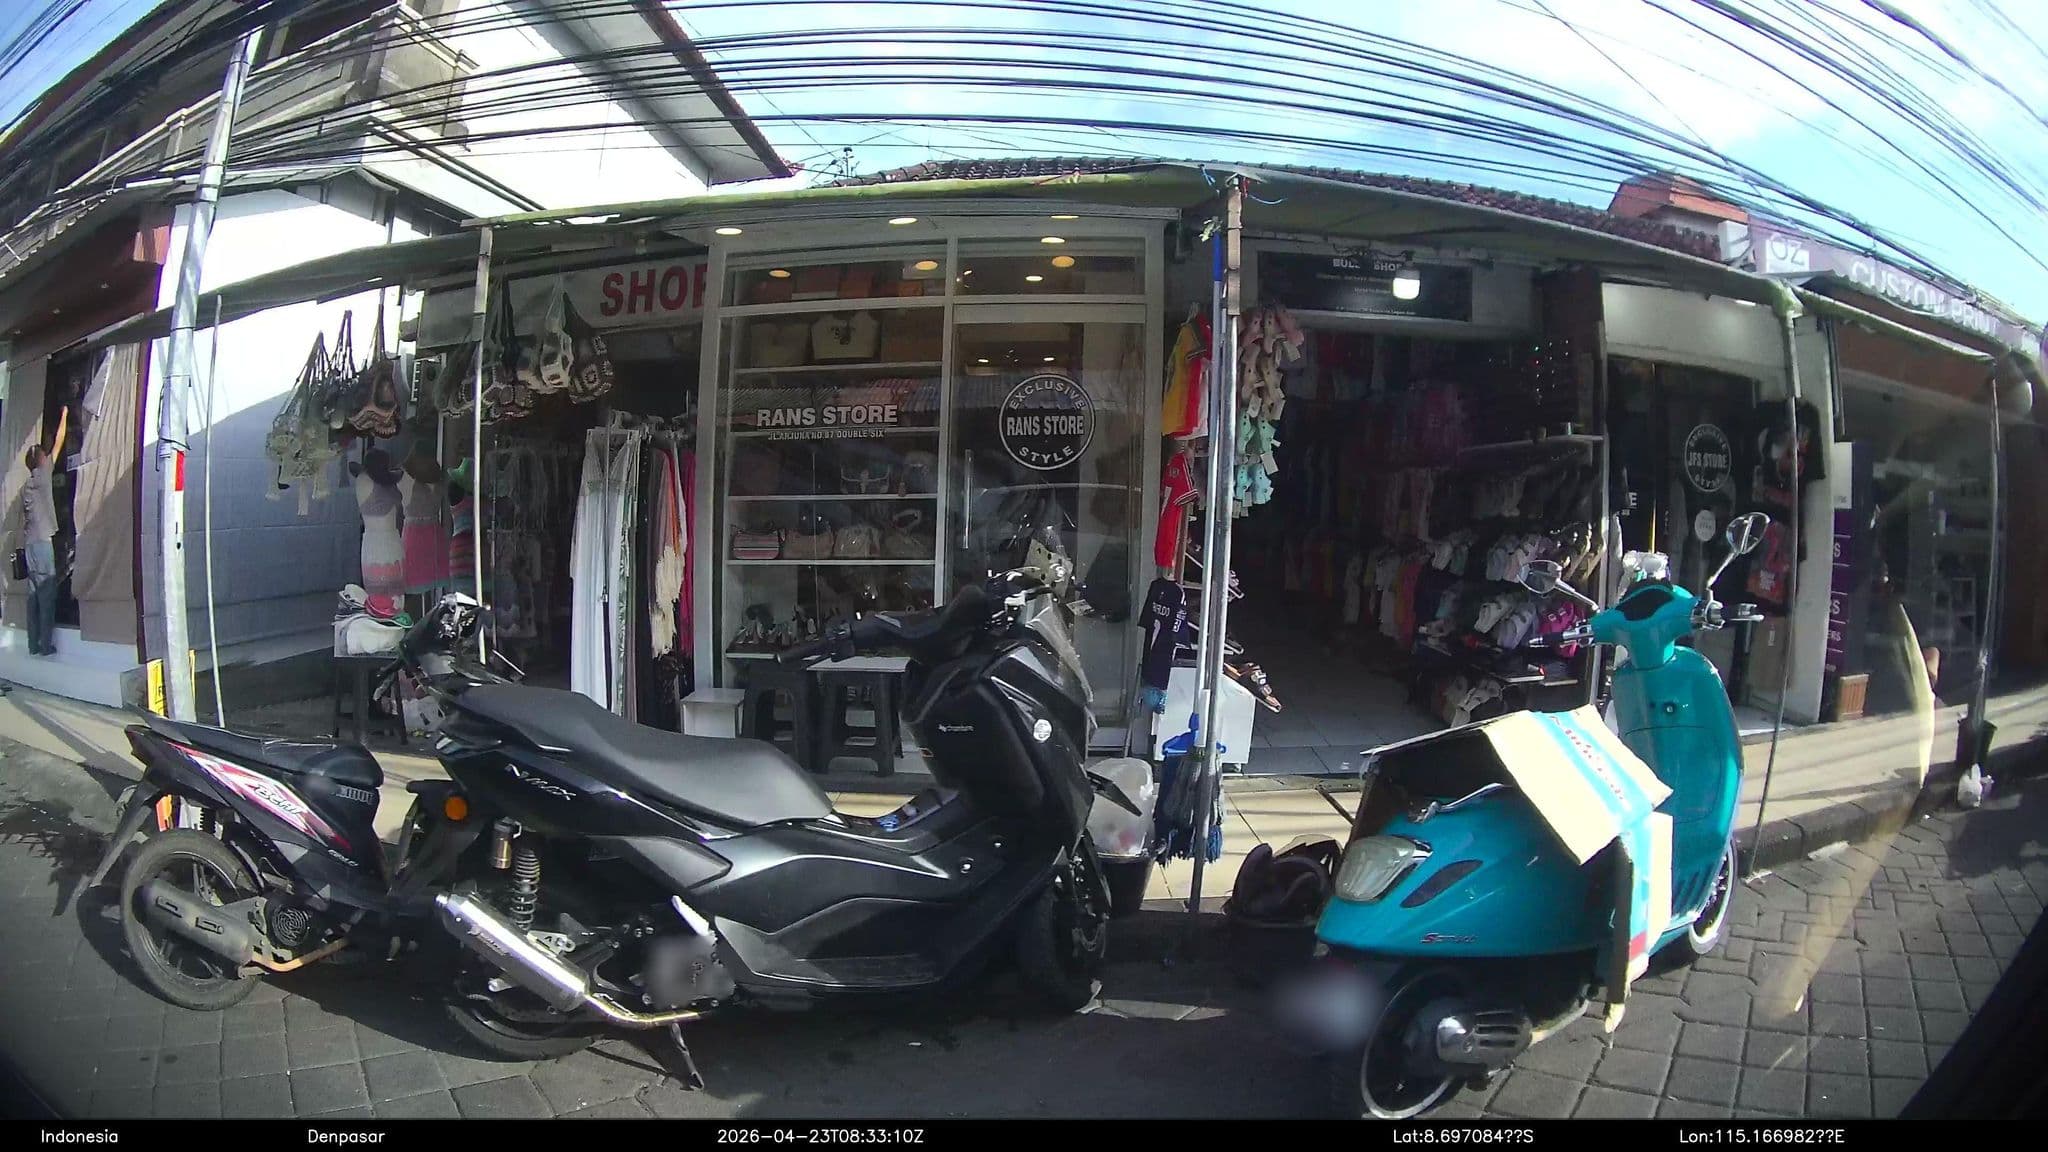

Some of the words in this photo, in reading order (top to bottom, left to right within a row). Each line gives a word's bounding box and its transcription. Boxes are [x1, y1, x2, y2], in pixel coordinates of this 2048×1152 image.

[1851, 261, 1944, 314] CUSTOM
[1009, 380, 1087, 411] EXCLUSIVE
[757, 407, 816, 427] RANS
[823, 404, 898, 424] STORE
[1006, 415, 1040, 436] RANS
[1043, 415, 1084, 435] STORE
[1019, 445, 1074, 463] STYLE
